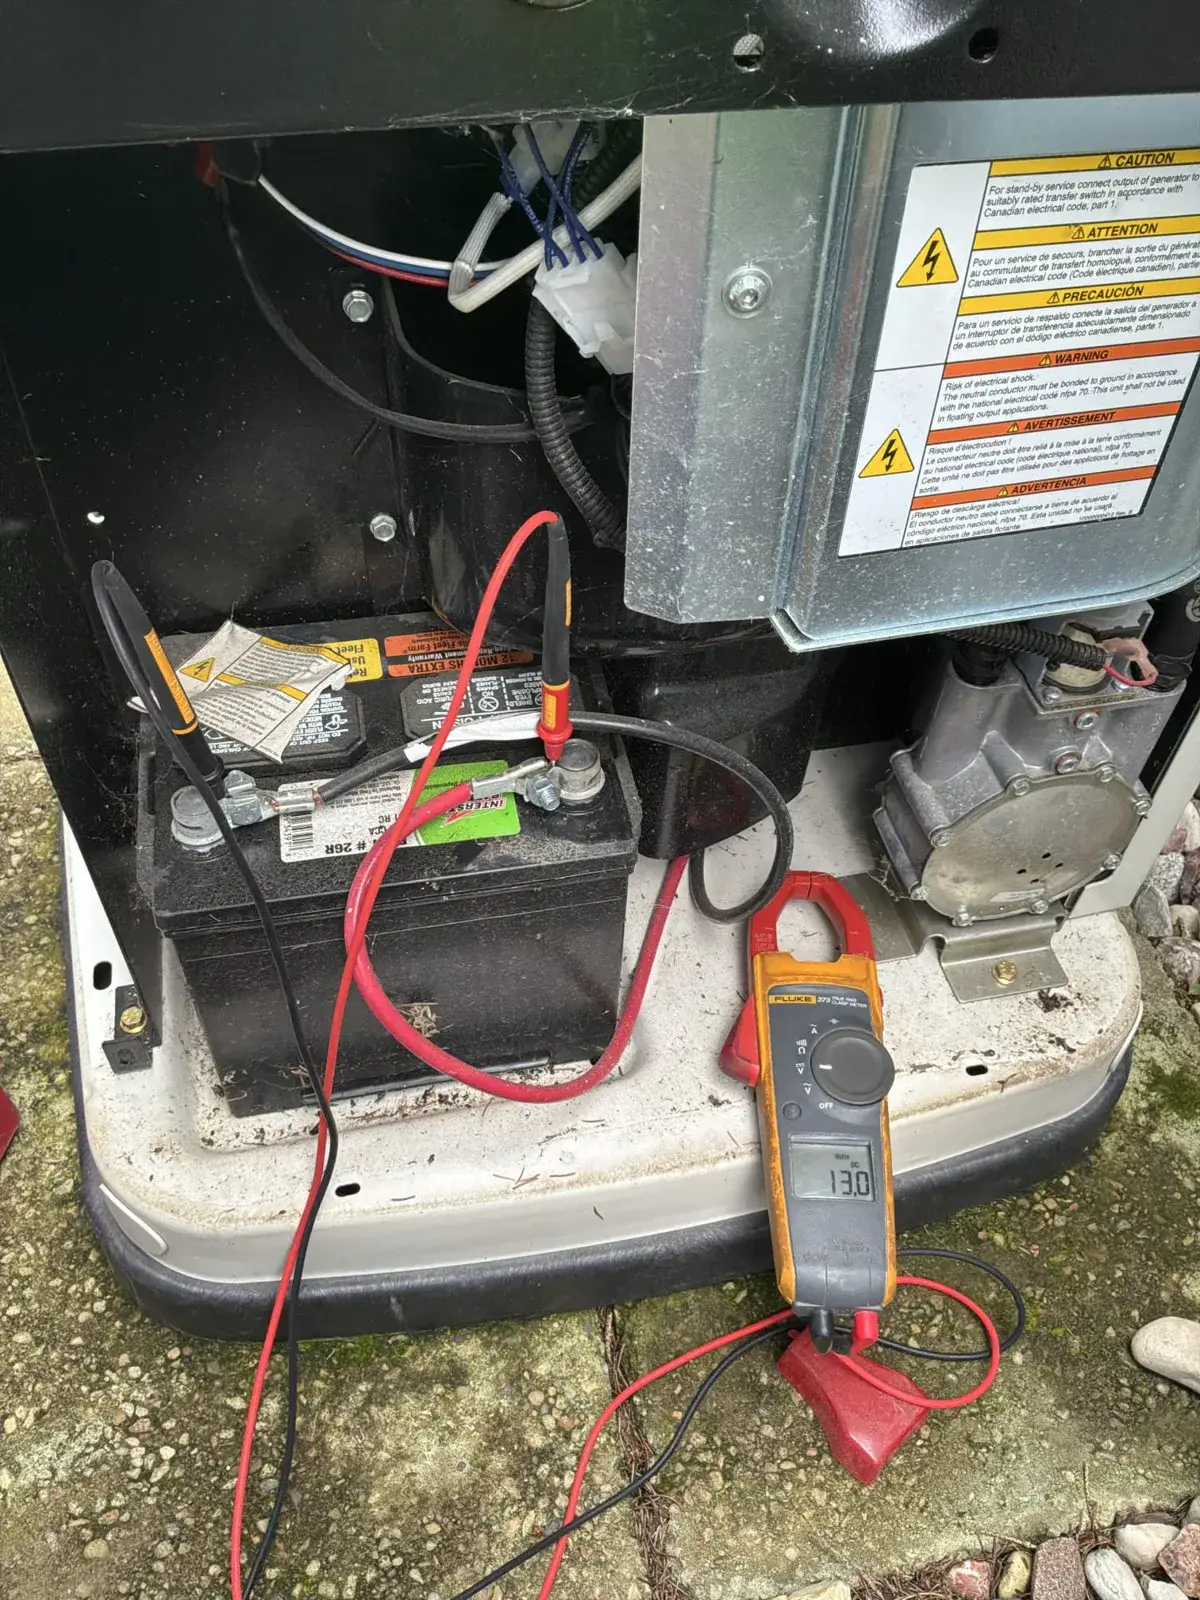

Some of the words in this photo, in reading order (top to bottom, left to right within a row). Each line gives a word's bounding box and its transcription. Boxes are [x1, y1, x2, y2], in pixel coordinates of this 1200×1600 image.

[1113, 152, 1175, 168] CAUTION
[1087, 223, 1158, 238] ATTENTION
[1062, 284, 1144, 302] PRECAUCIÓN
[1055, 349, 1109, 363] WARNING
[1024, 411, 1116, 429] AVERTISSEMENT
[1011, 477, 1086, 493] ADVERTENCIA
[408, 662, 444, 674] EXTRA
[378, 814, 391, 824] RC
[324, 842, 352, 855] 26R
[830, 1170, 870, 1196] 13.0
